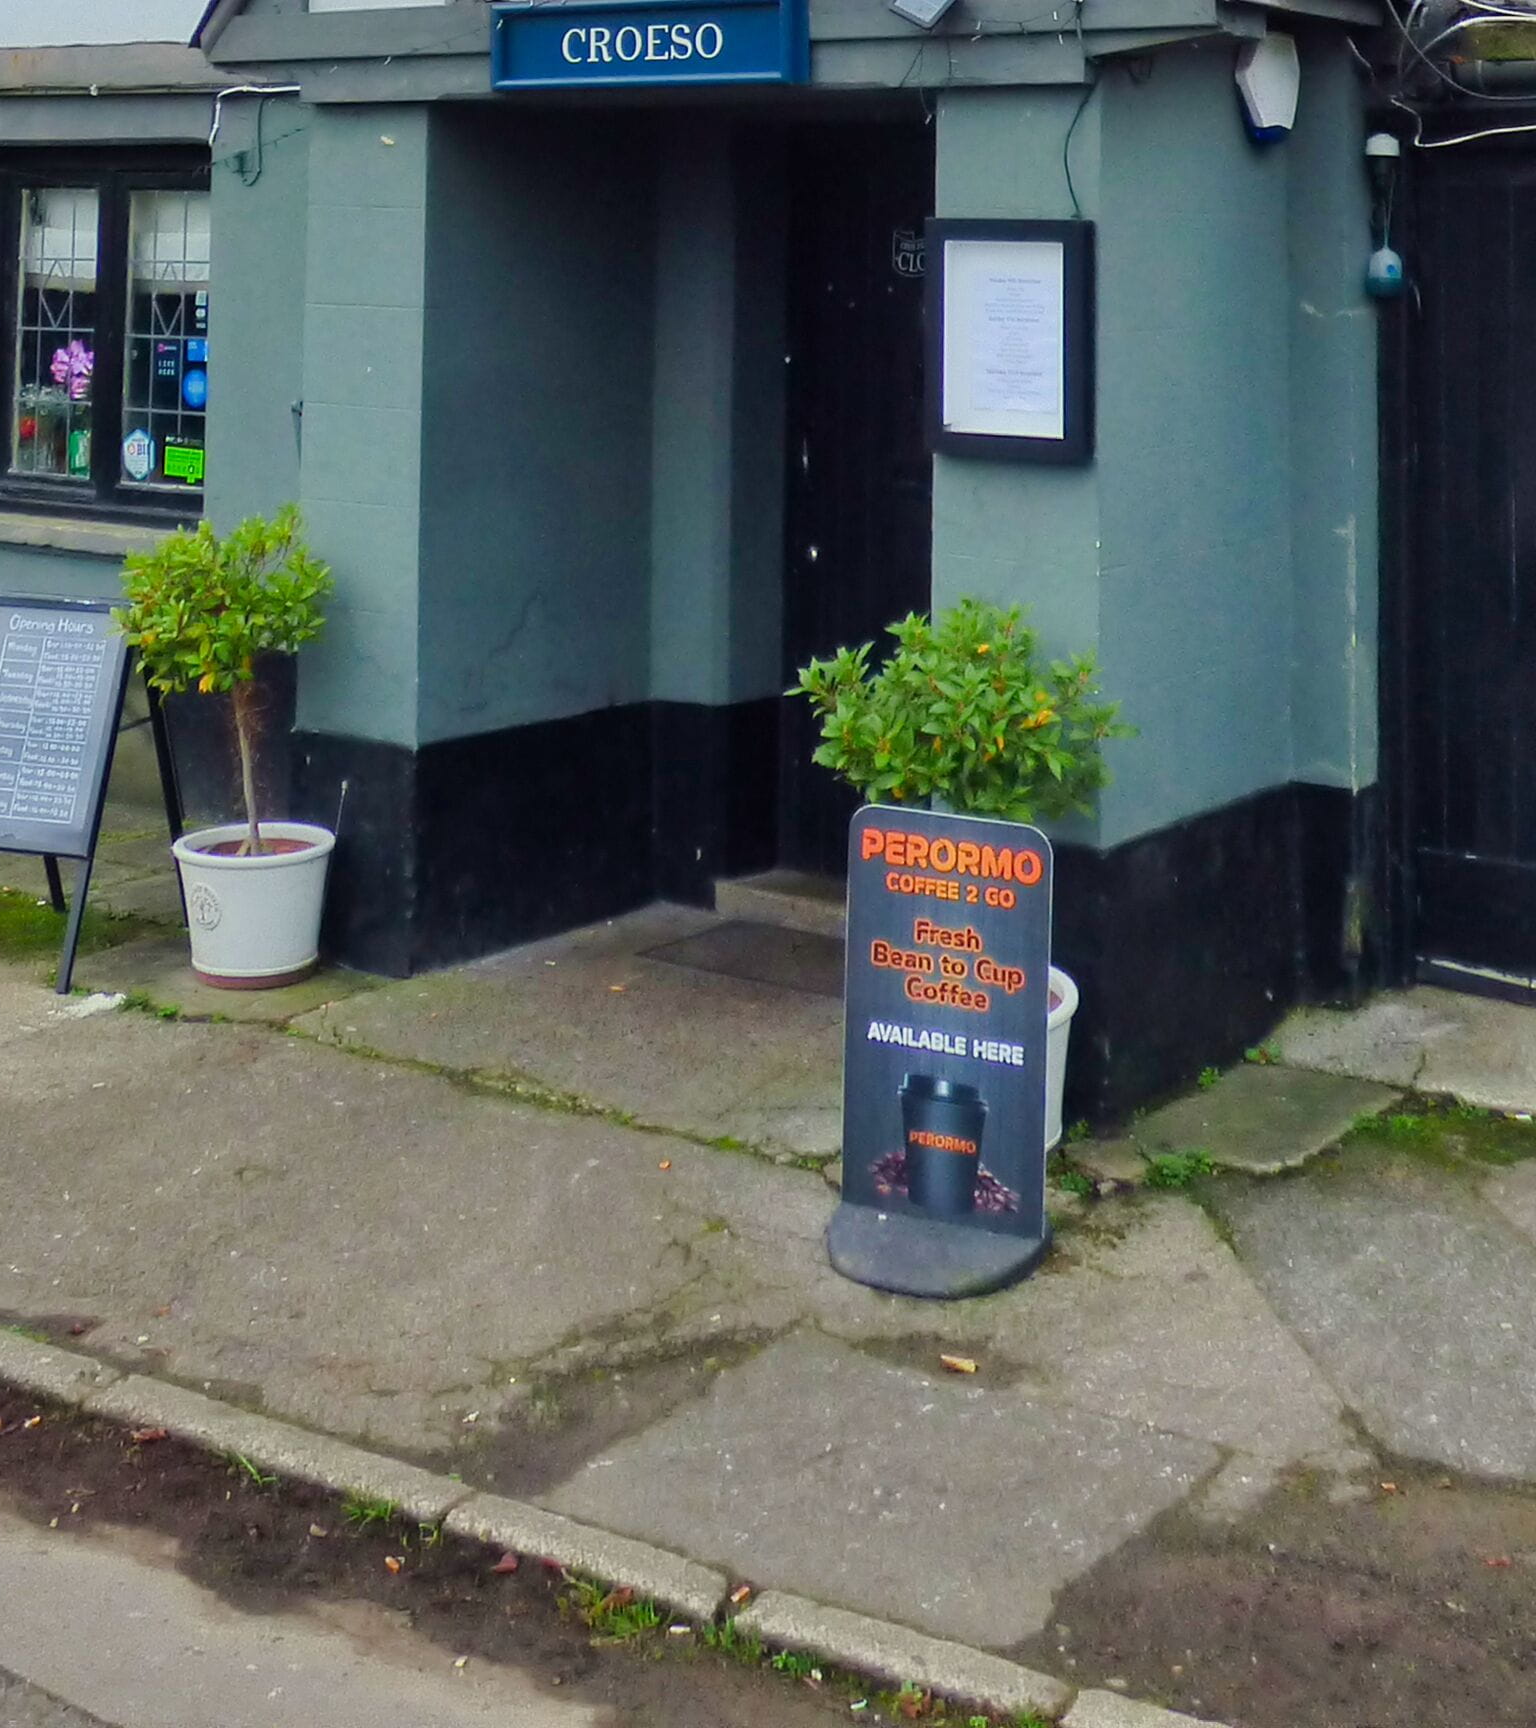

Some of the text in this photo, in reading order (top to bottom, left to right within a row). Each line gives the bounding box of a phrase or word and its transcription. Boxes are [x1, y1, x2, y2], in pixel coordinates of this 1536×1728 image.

[562, 22, 724, 64] CROESO
[9, 614, 94, 634] Opening Hours
[861, 827, 1044, 886] PERORMO
[885, 871, 1016, 910] COFFEE 2 GO
[914, 918, 983, 953] Fresh
[871, 939, 1026, 993] Bean to Cup
[905, 974, 990, 1013] Coffee
[867, 1021, 1025, 1066] AVAILABLE HERE
[908, 1130, 977, 1154] PERORMO
